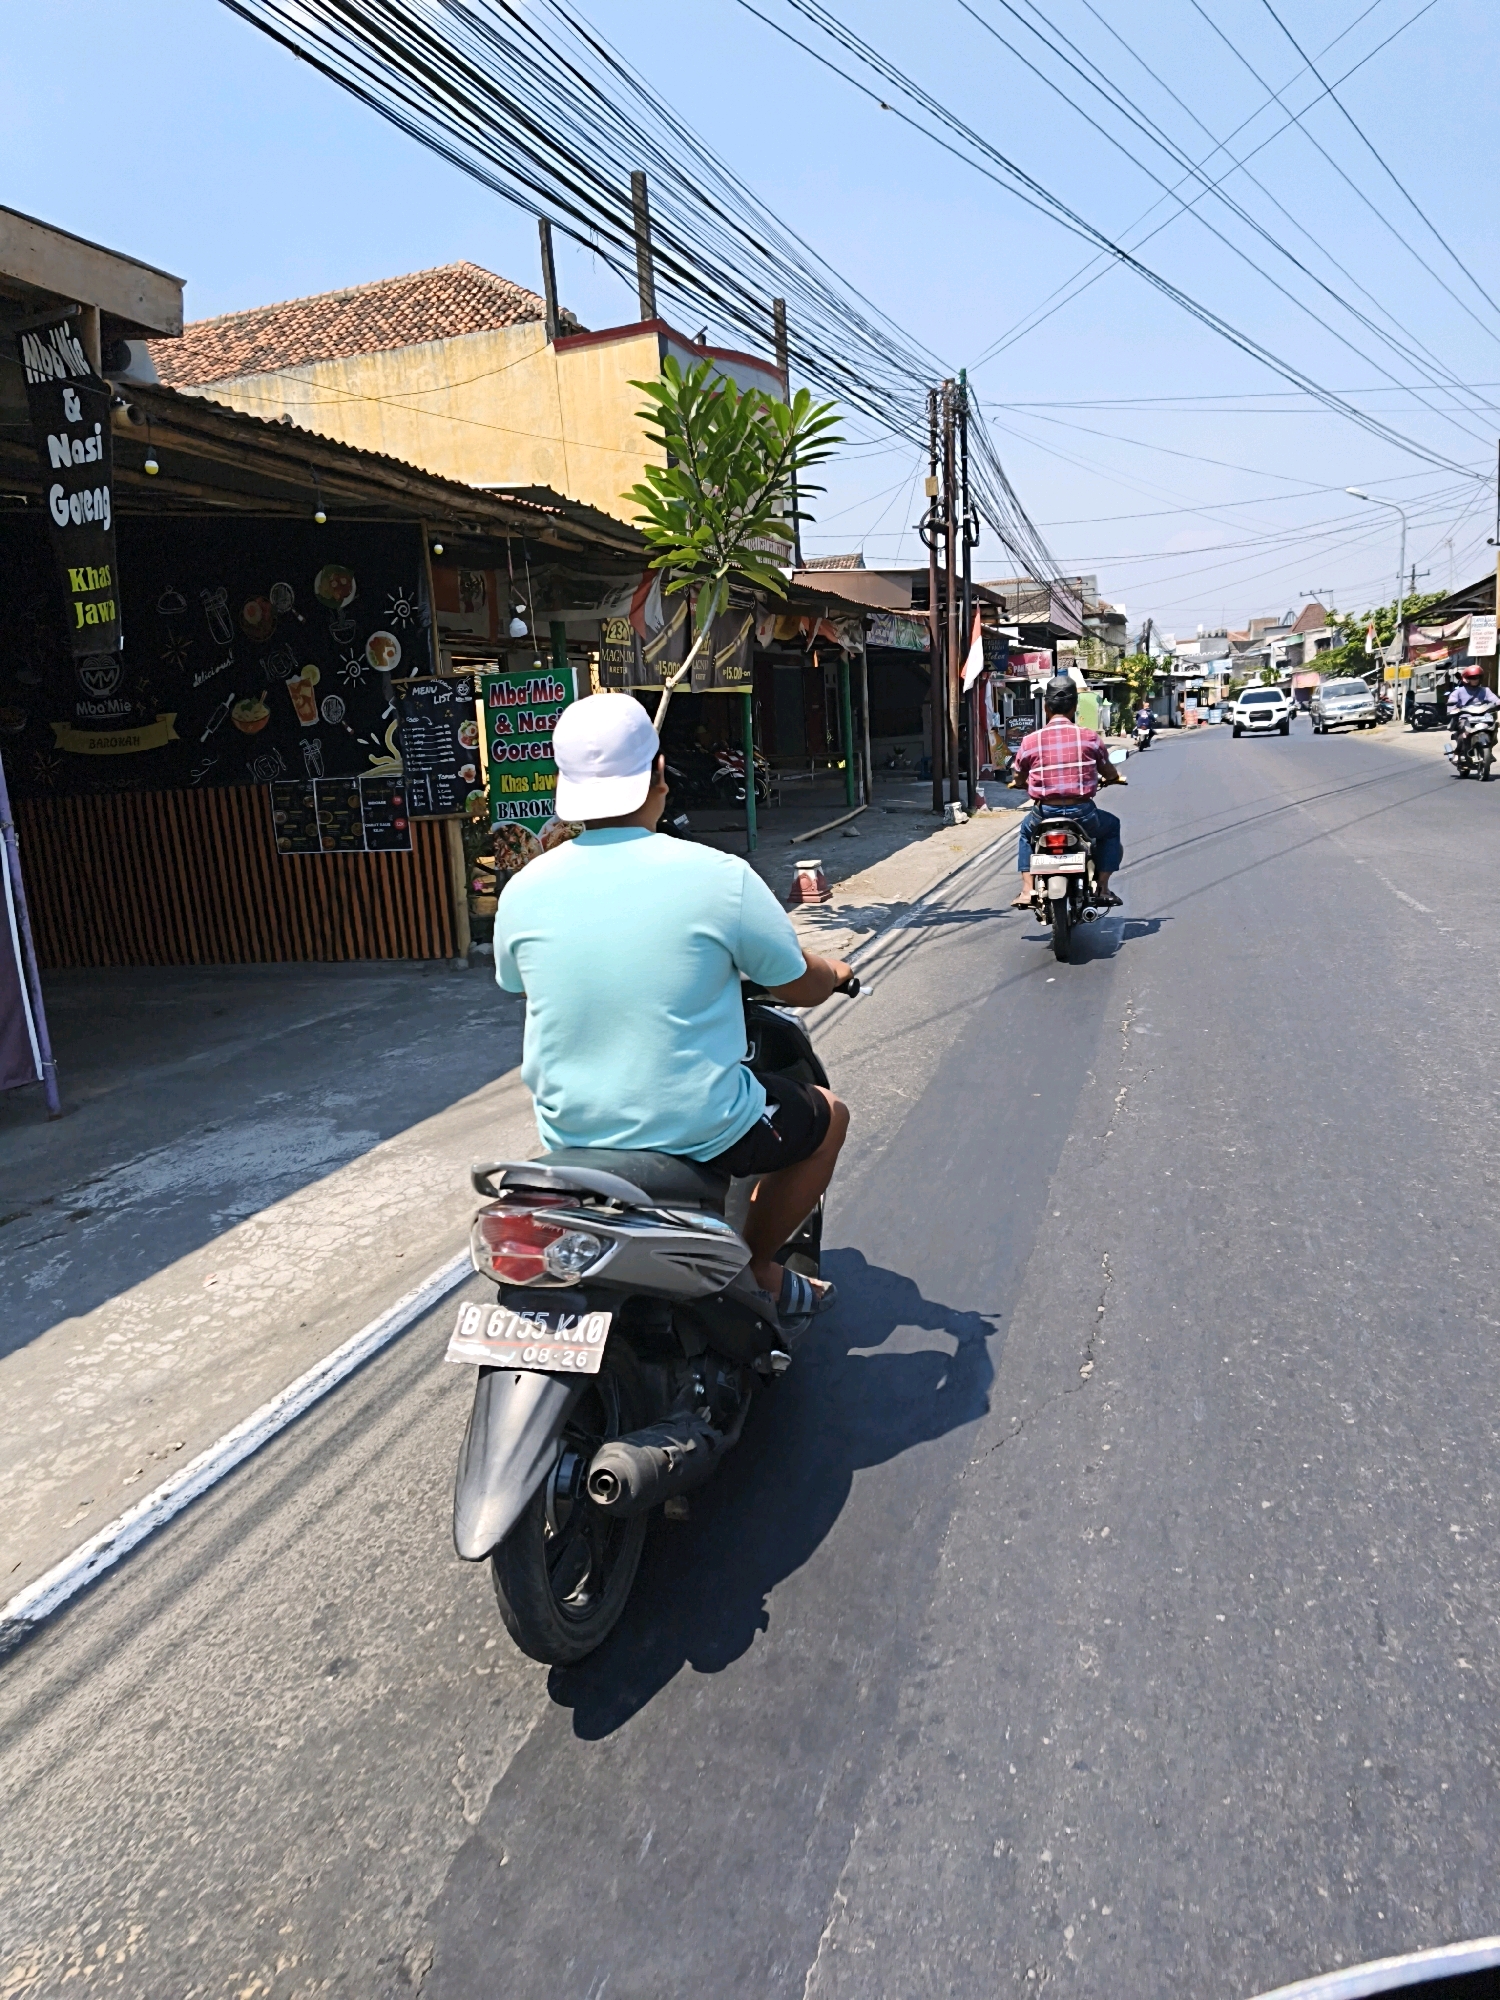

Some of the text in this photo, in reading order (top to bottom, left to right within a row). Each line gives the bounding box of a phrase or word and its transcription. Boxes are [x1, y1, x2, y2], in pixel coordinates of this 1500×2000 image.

[63, 388, 82, 422] &
[47, 423, 103, 468] Nasi
[49, 483, 112, 531] Goreng
[68, 563, 112, 592] Khas
[75, 598, 117, 628] Jawa
[602, 649, 634, 663] MAGNUM
[412, 686, 438, 696] MENU
[433, 692, 455, 705] LIST
[489, 675, 565, 707] Mba'Mie
[76, 699, 132, 715] Mba'Mie
[495, 713, 514, 735] &
[89, 736, 140, 749] BAROKAH
[491, 739, 554, 763] Goren
[501, 772, 556, 793] Khas Jaw
[496, 799, 556, 820] BAROK
[460, 1306, 481, 1335] B
[486, 1309, 549, 1340] 6755
